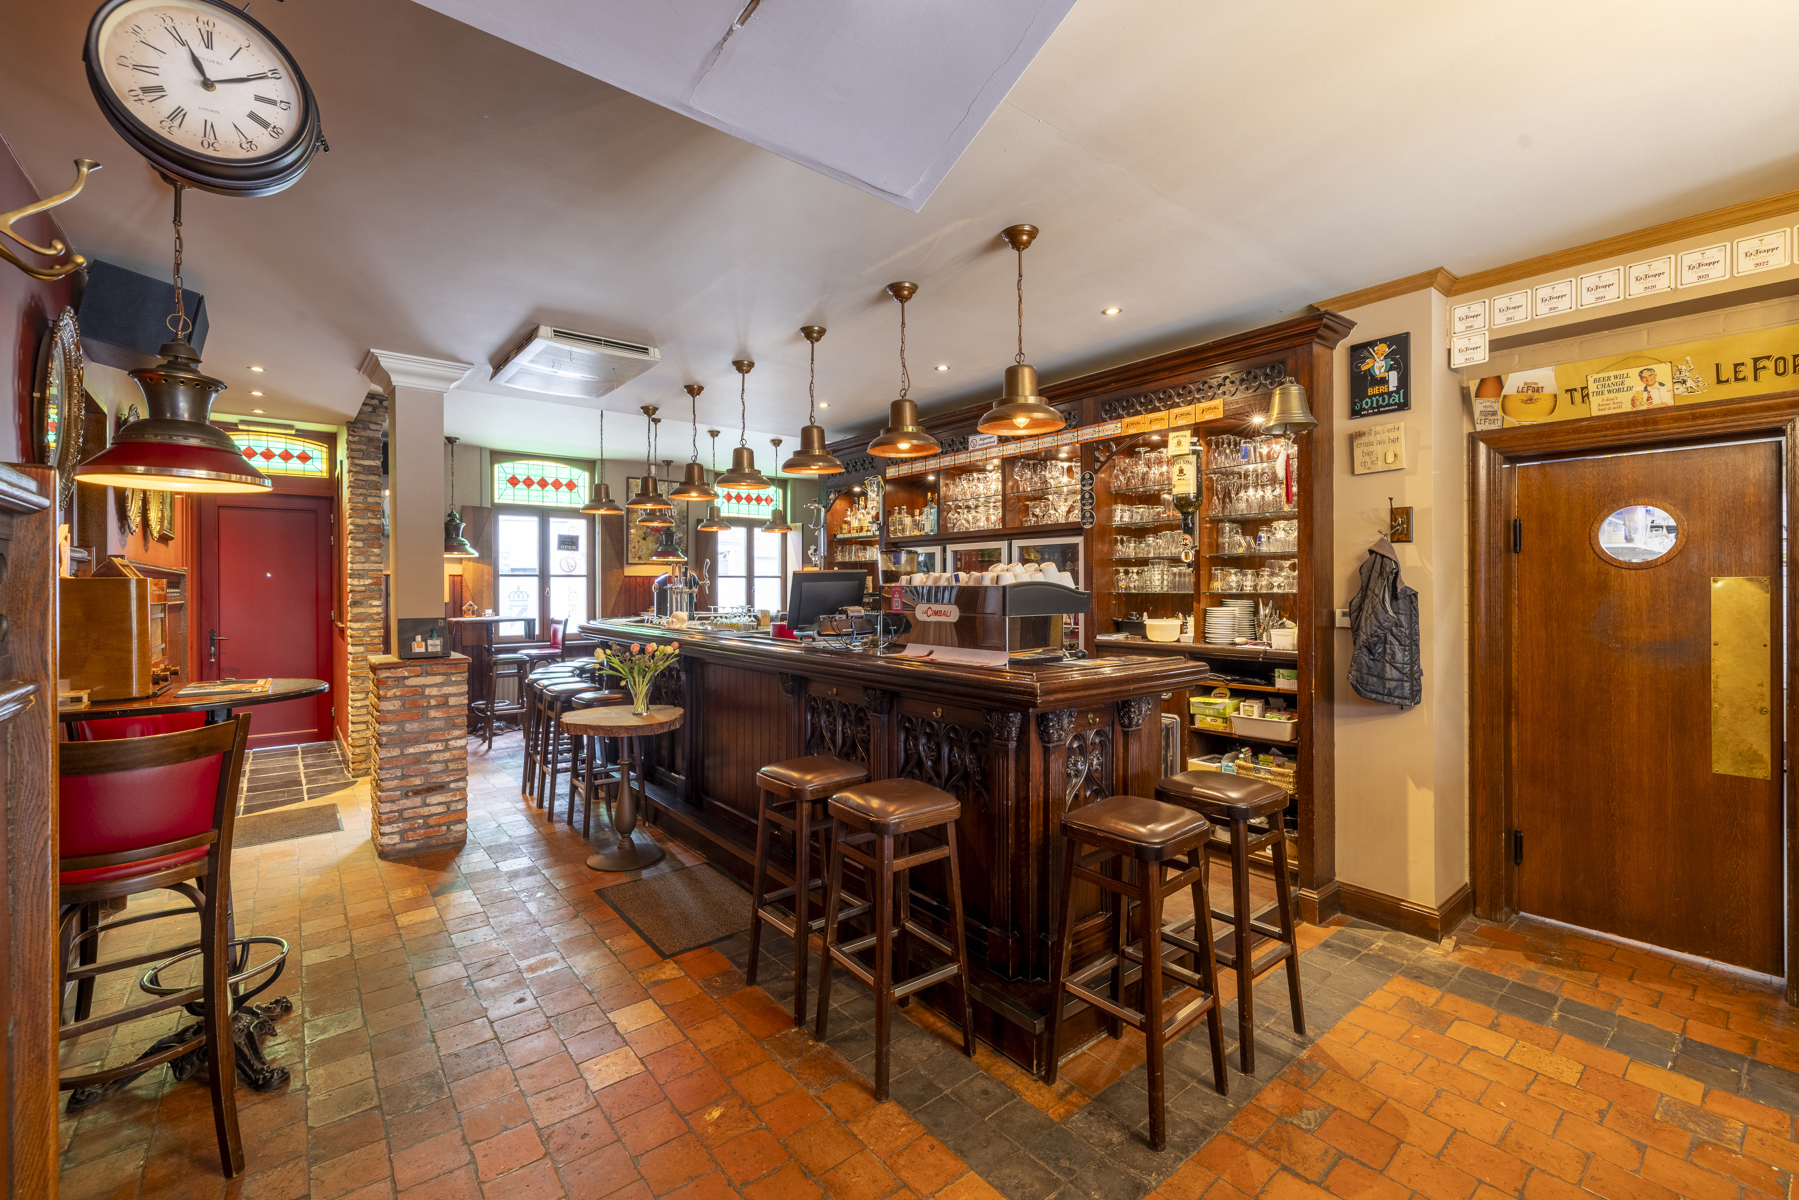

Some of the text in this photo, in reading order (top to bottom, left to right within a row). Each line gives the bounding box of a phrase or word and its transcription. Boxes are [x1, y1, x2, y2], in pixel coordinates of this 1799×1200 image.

[196, 16, 216, 29] 60
[198, 27, 214, 51] XII
[253, 94, 278, 107] III
[166, 105, 188, 129] VII
[202, 119, 218, 141] VI
[200, 139, 220, 153] 30
[1753, 260, 1770, 268] 2022
[1593, 372, 1631, 384] BEER WILL
[1367, 384, 1389, 396] BIÈRE
[1596, 379, 1626, 390] CHANGE
[1607, 385, 1634, 395] WORLD!
[1387, 435, 1399, 444] het
[926, 607, 952, 618] CIMBALI
